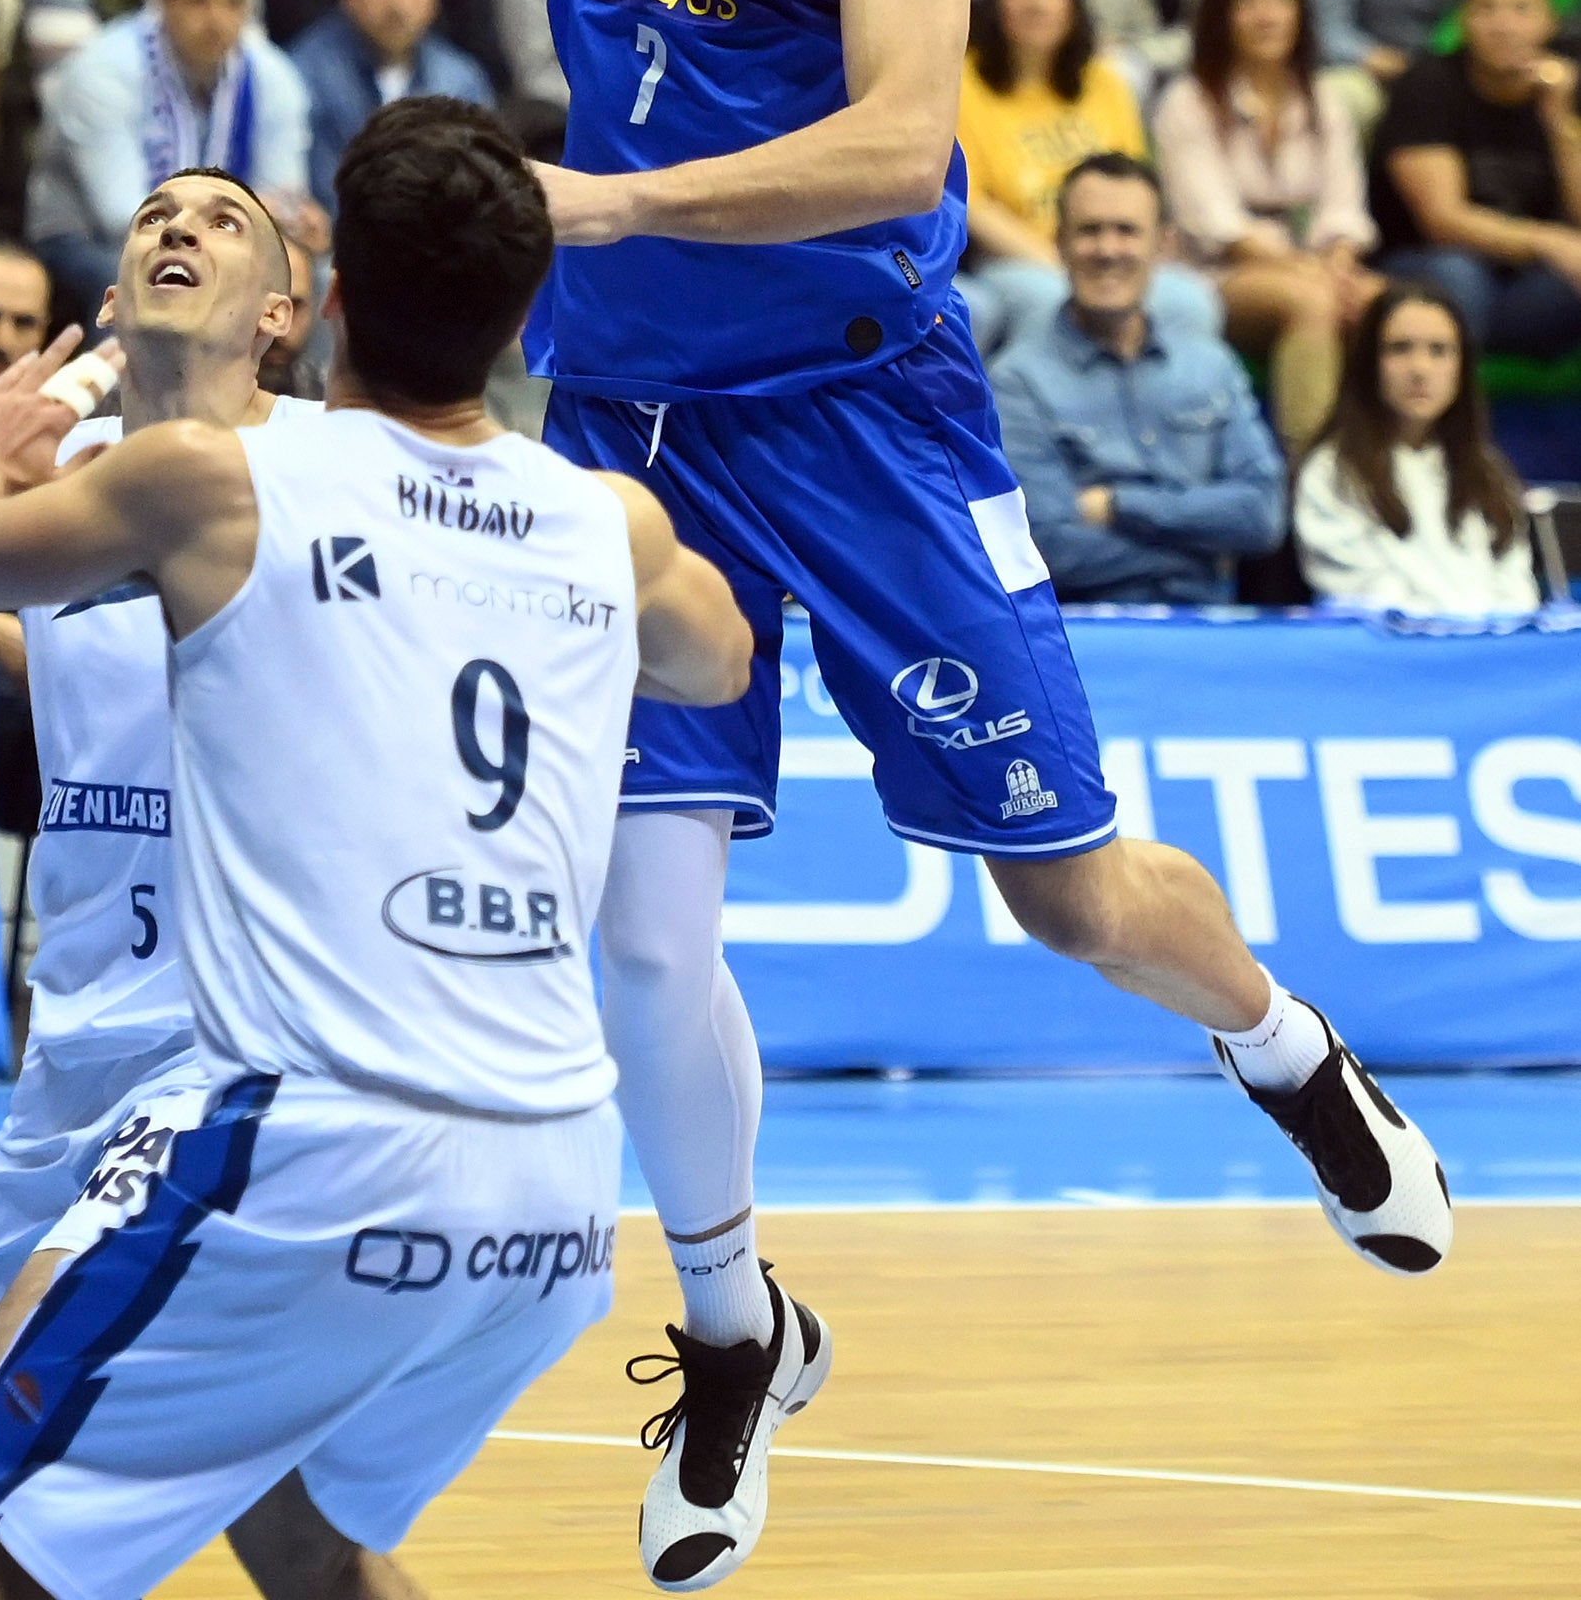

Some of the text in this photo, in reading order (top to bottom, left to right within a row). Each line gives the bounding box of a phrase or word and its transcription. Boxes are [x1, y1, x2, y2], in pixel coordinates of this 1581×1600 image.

[628, 22, 668, 126] 7
[451, 658, 531, 833] 9
[907, 709, 1032, 751] LXUS
[38, 783, 167, 832] UENLAB
[1004, 793, 1055, 816] BURGOS
[129, 883, 160, 961] 5
